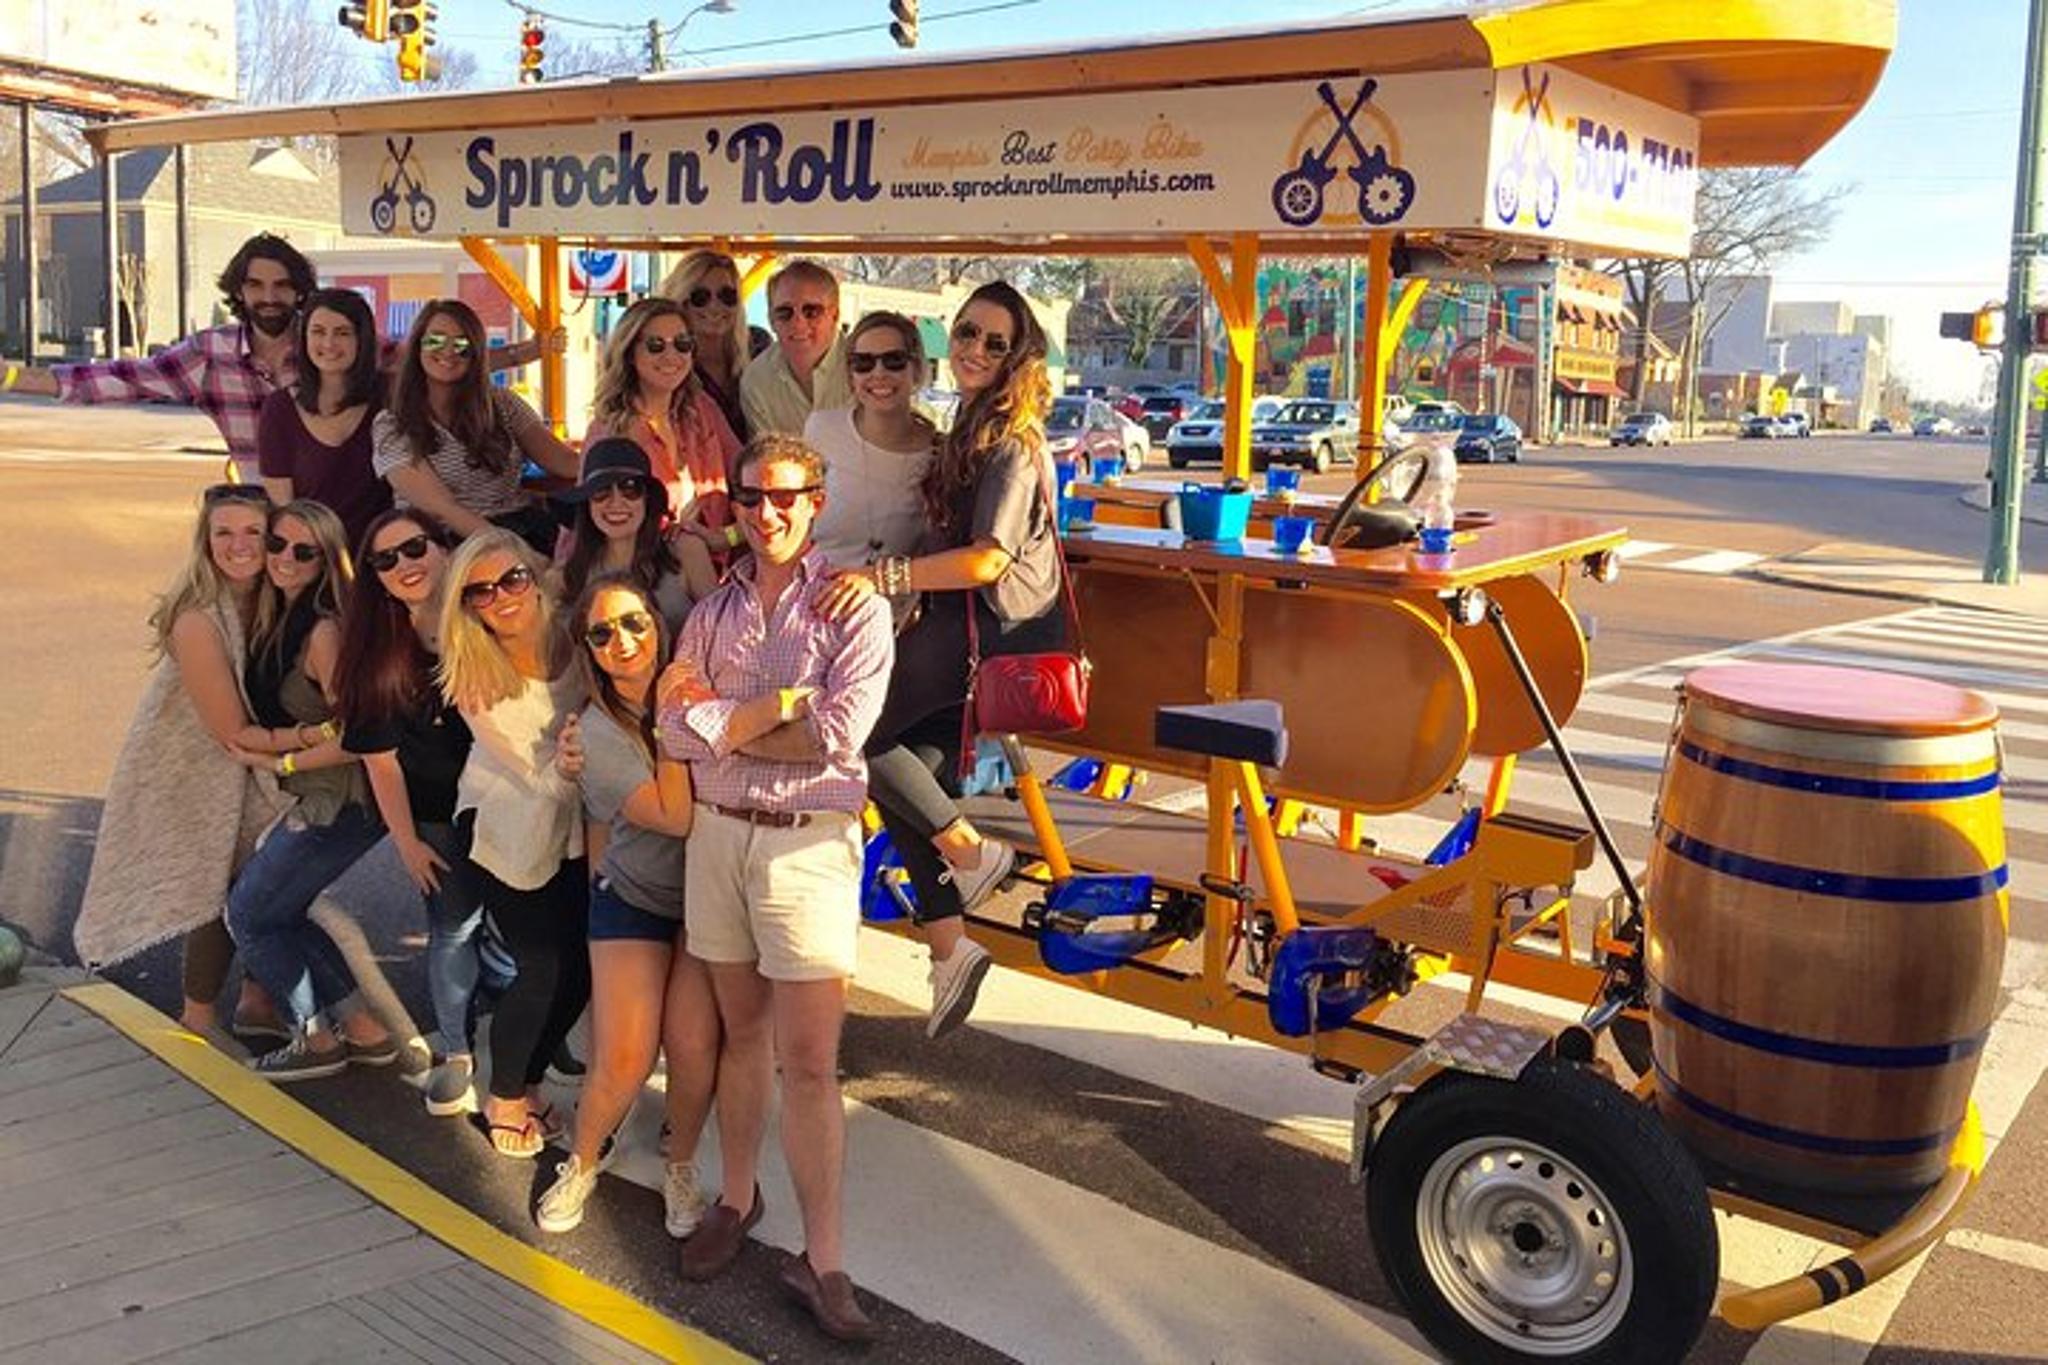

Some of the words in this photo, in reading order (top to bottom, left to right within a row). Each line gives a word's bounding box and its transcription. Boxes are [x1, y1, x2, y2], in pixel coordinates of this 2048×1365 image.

[1001, 129, 1057, 165] Best
[1064, 126, 1132, 168] Party
[1140, 122, 1205, 160] Bike
[465, 130, 658, 228] Sprock
[724, 117, 880, 203] Roll
[890, 168, 1215, 202] www.sprocknrollmemphis.com
